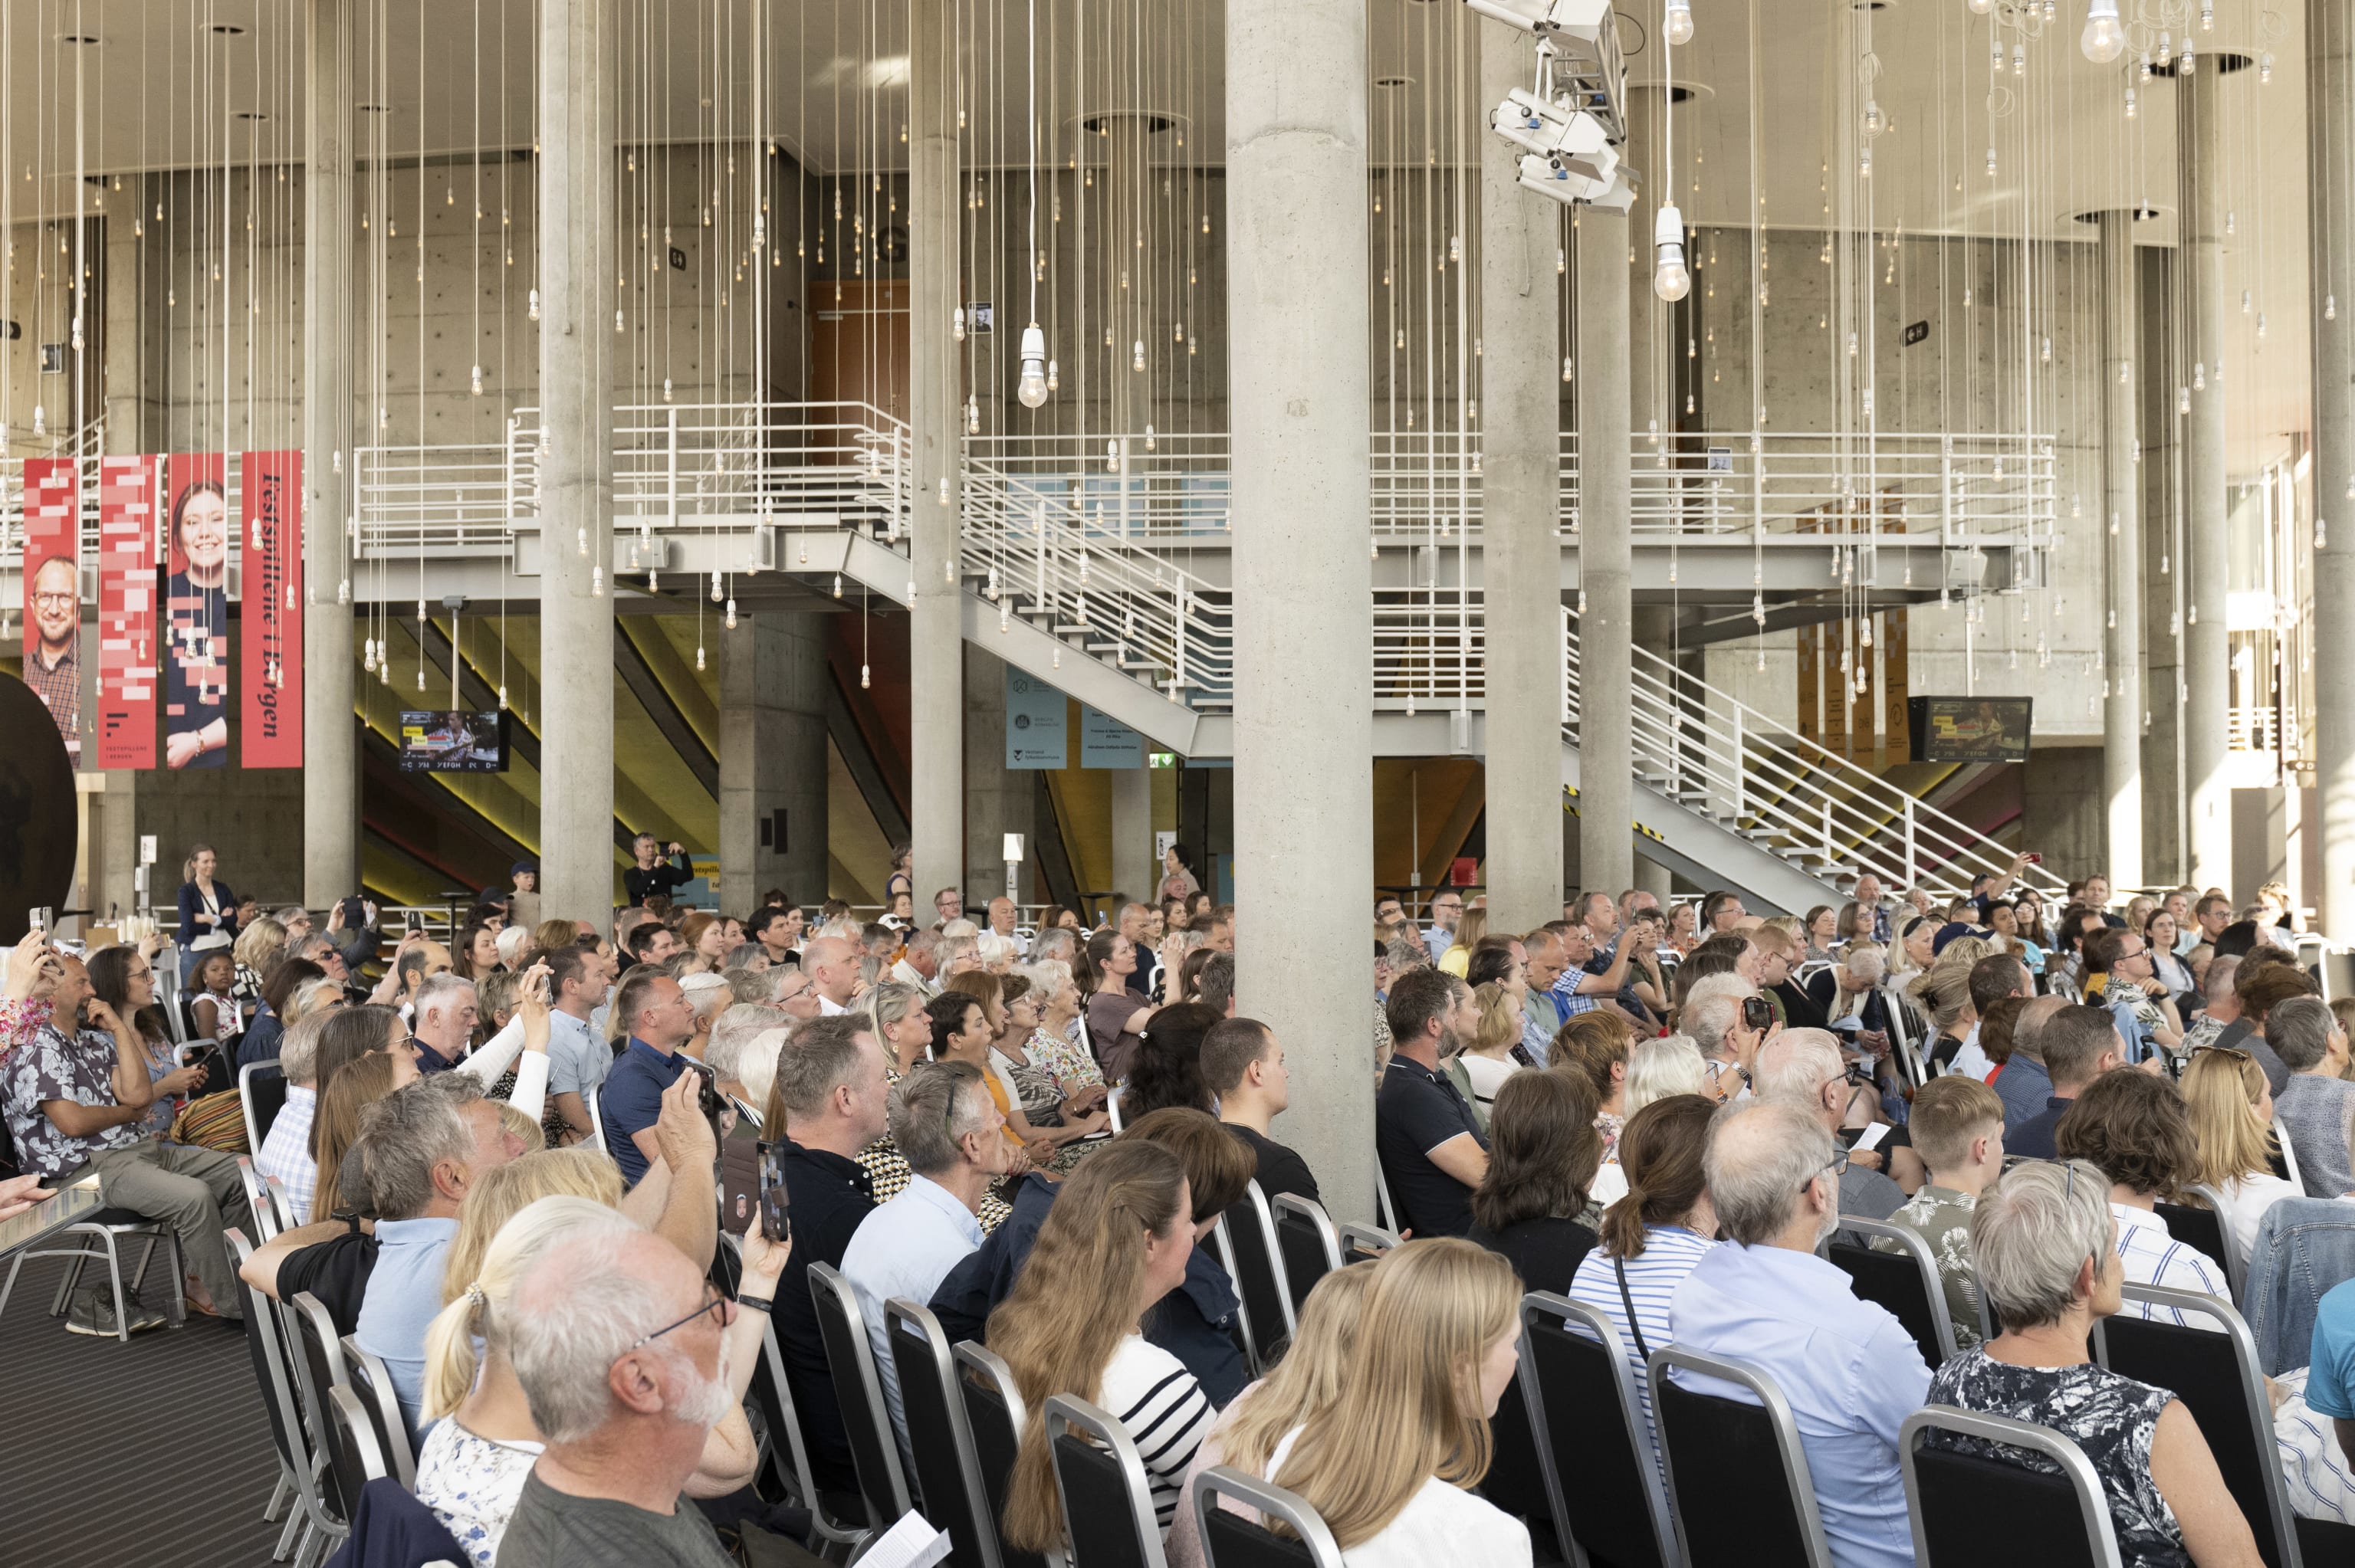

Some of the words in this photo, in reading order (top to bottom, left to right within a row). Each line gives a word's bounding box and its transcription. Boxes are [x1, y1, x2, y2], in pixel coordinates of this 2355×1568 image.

[876, 226, 906, 262] G
[1917, 325, 1922, 338] H
[261, 474, 283, 625] Festspillene
